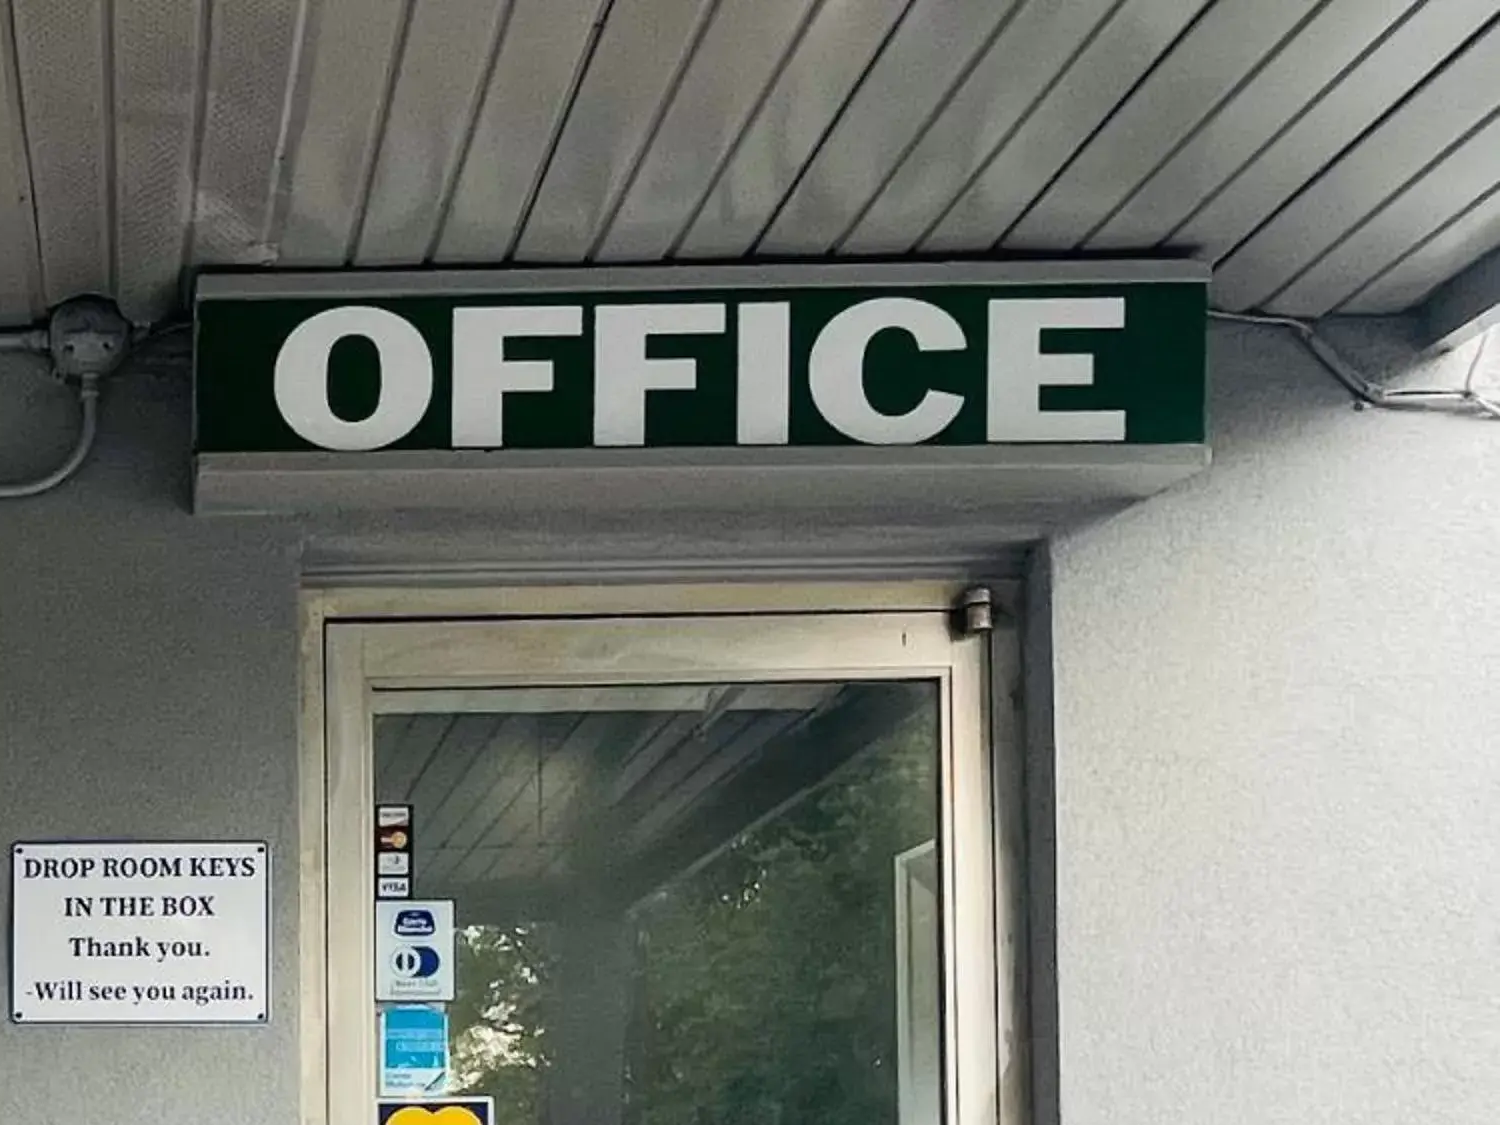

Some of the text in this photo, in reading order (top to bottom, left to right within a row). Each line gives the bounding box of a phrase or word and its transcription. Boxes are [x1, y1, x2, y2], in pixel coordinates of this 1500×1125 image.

[273, 296, 1126, 451] OFFICE
[24, 857, 256, 878] DROP ROOM KEYS
[64, 896, 215, 917] IN THE BOX
[69, 937, 210, 963] Thank you.
[89, 985, 127, 1001] see
[133, 986, 176, 1005] you
[181, 980, 254, 1006] again.
